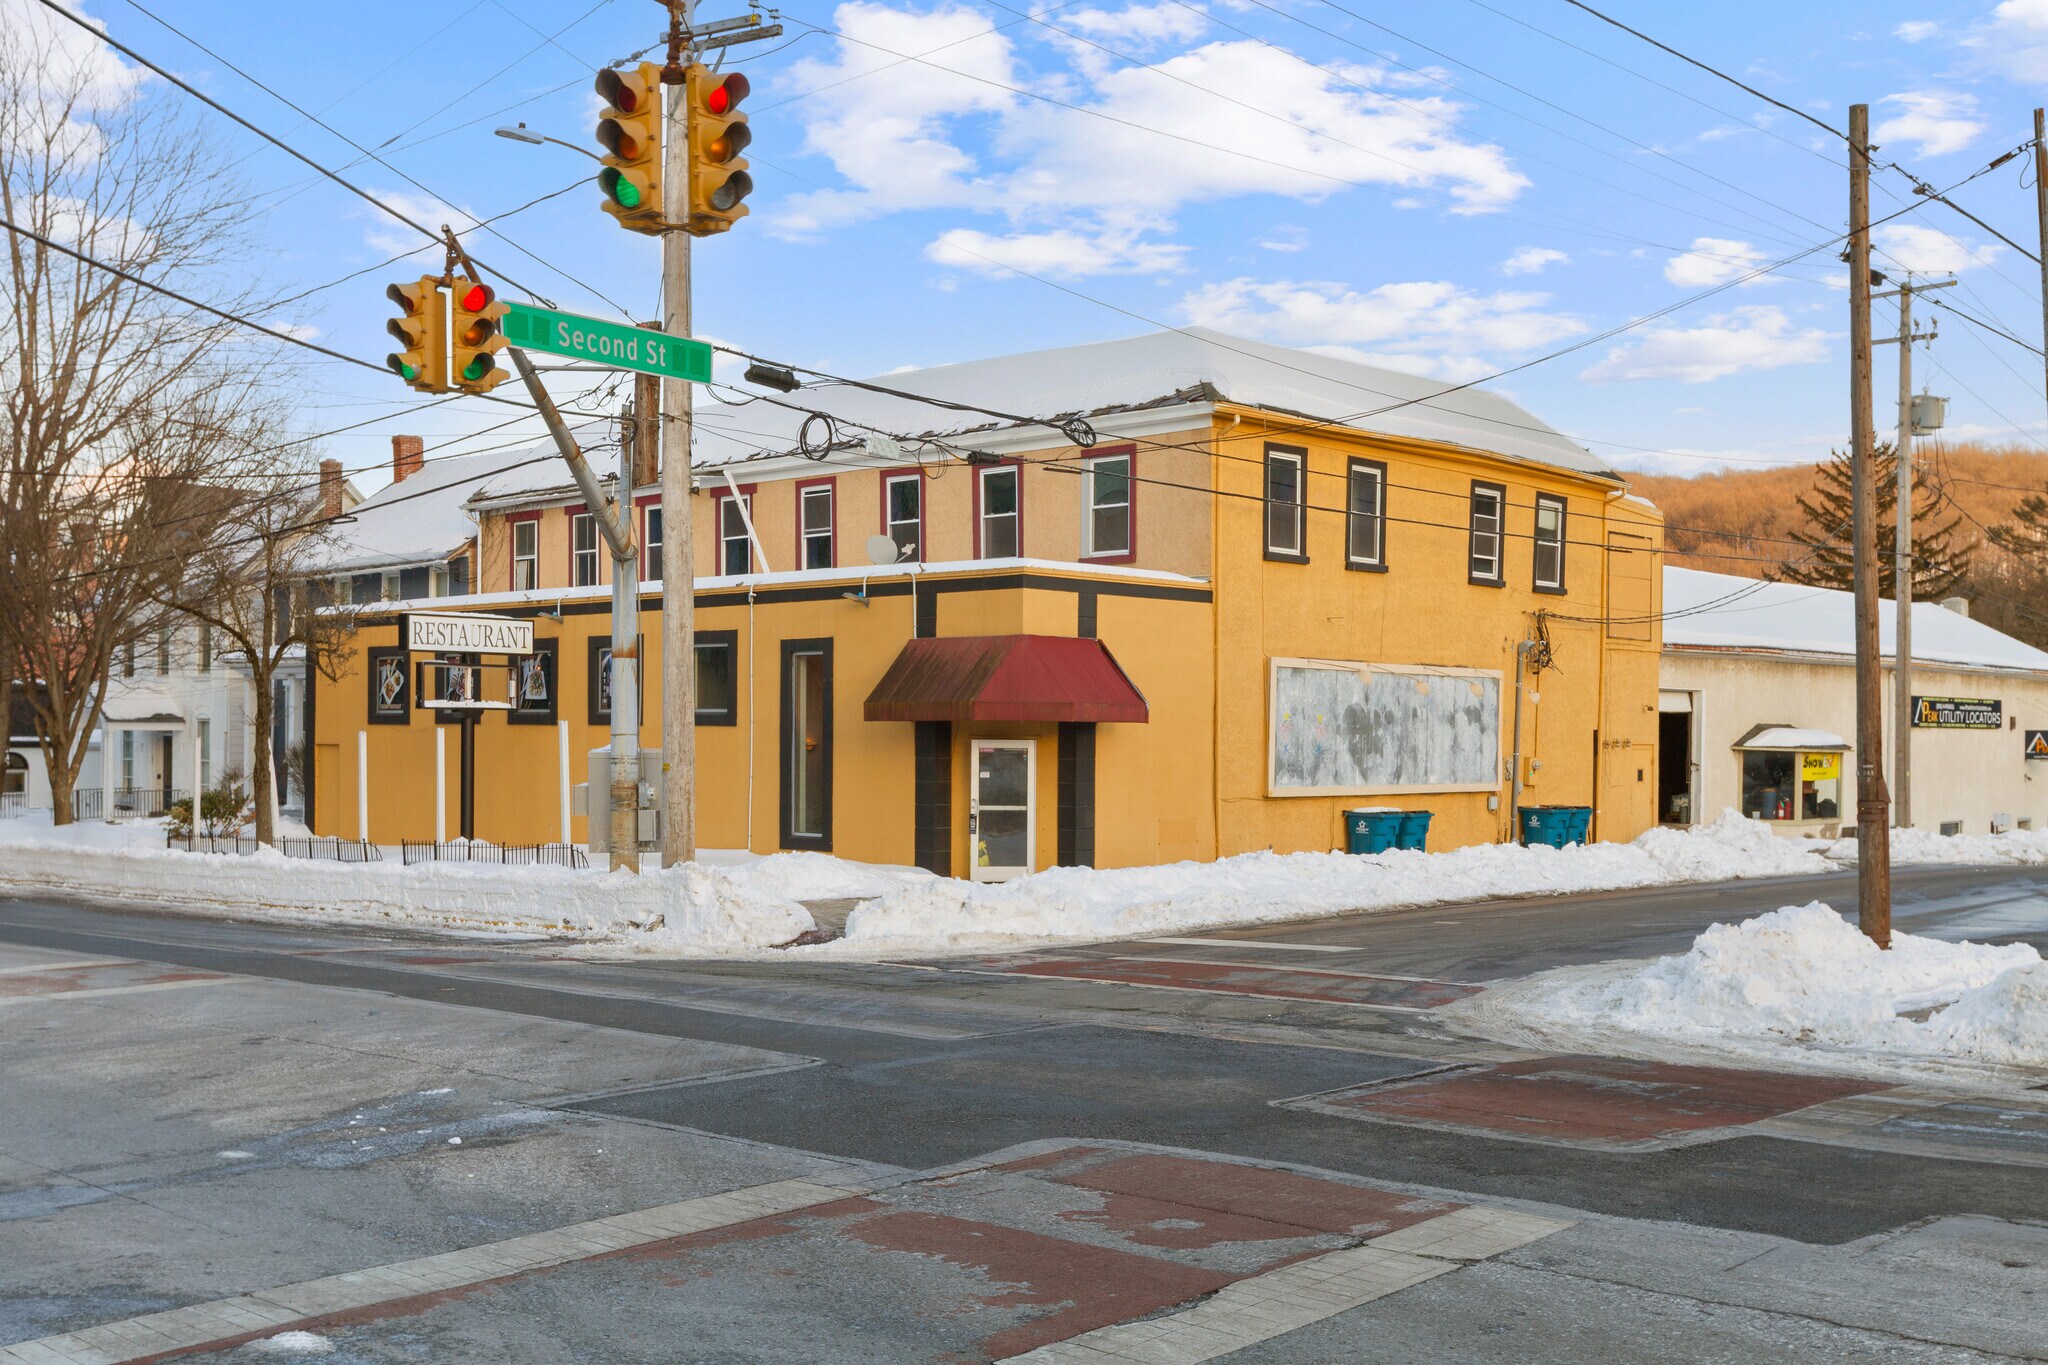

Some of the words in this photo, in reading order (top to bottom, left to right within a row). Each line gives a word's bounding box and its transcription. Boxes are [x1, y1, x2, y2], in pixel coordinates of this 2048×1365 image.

[557, 321, 638, 361] Second
[646, 340, 667, 367] St
[412, 621, 530, 649] RESTAURANT
[1939, 710, 1965, 723] UTILITY
[1965, 711, 2001, 724] LOCATORS
